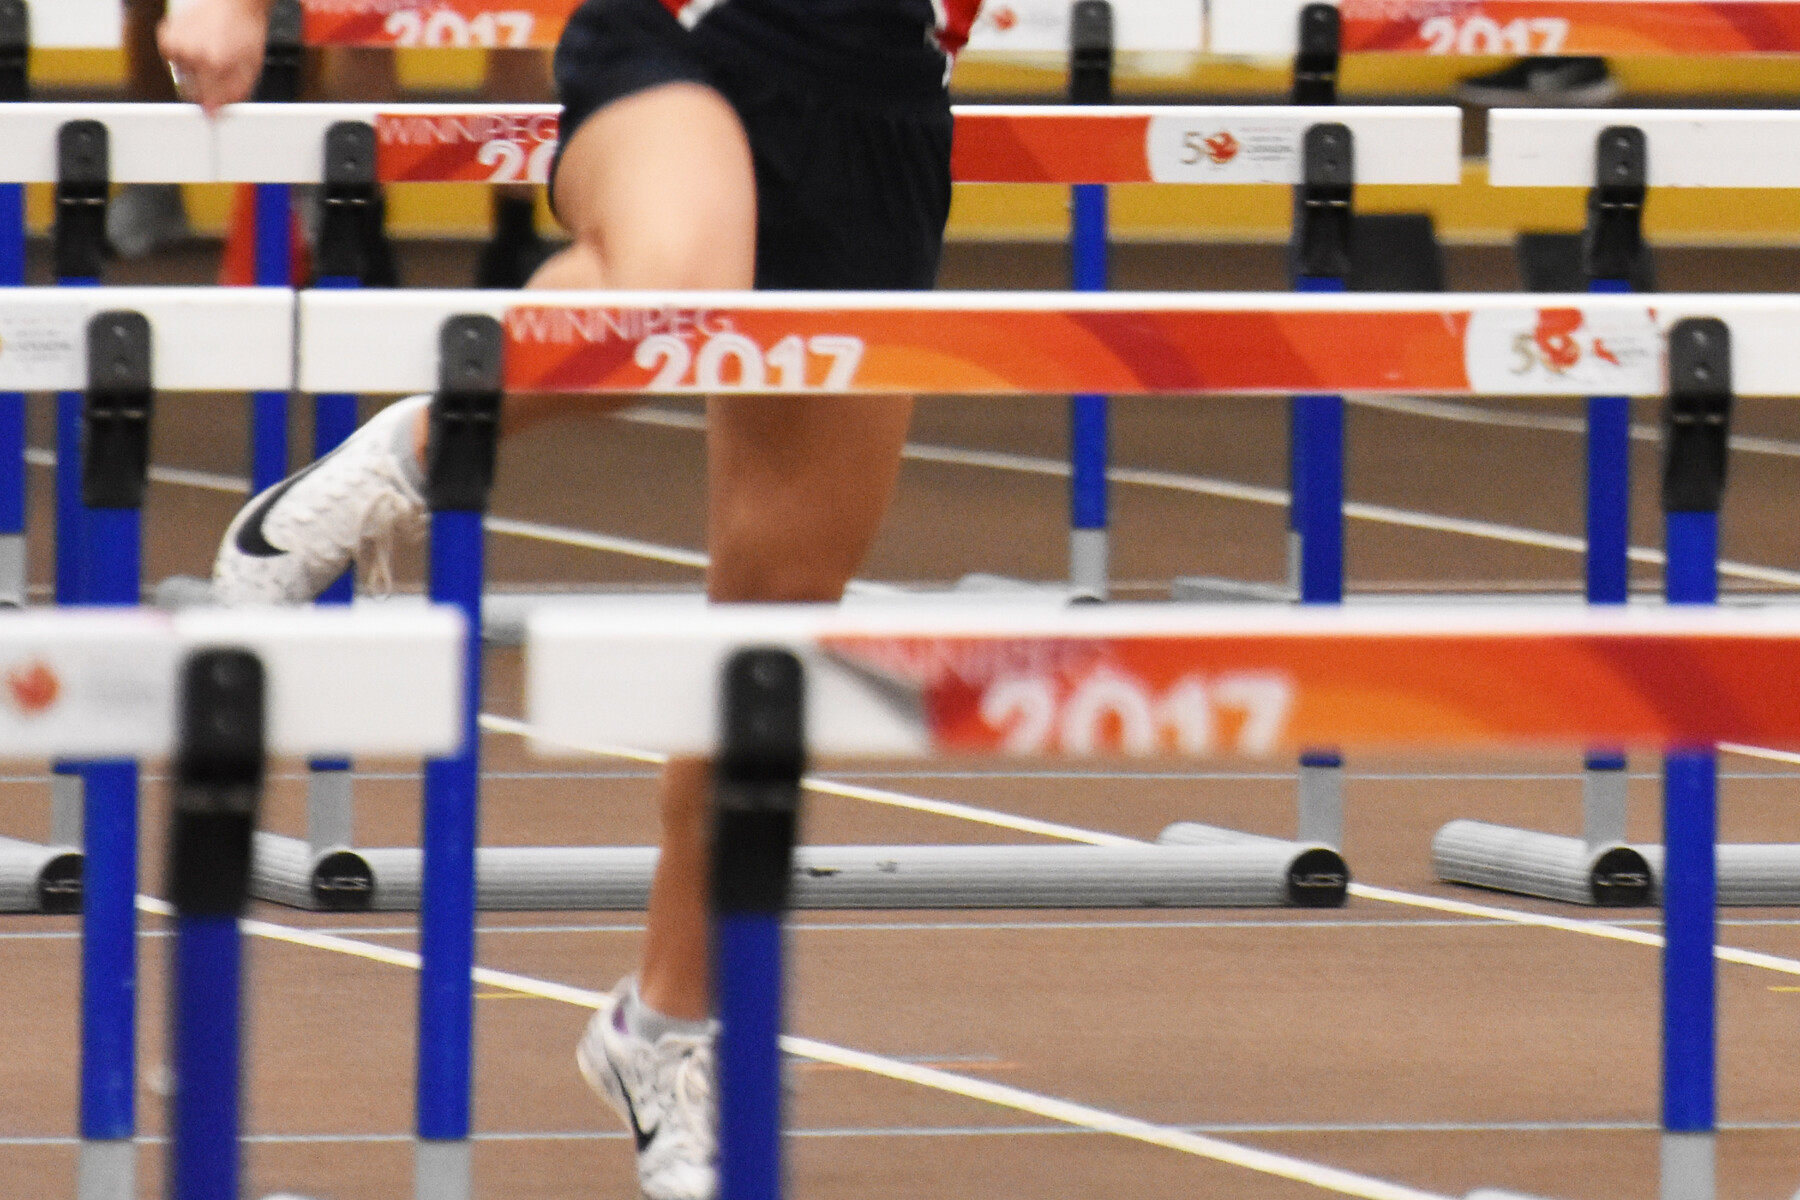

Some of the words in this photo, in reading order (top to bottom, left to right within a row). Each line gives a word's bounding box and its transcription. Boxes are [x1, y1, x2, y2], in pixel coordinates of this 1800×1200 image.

[384, 10, 534, 48] 2017
[1419, 16, 1570, 55] 2017
[503, 307, 734, 345] WINNIPEG
[634, 333, 865, 393] 2017
[977, 667, 1291, 756] 2017
